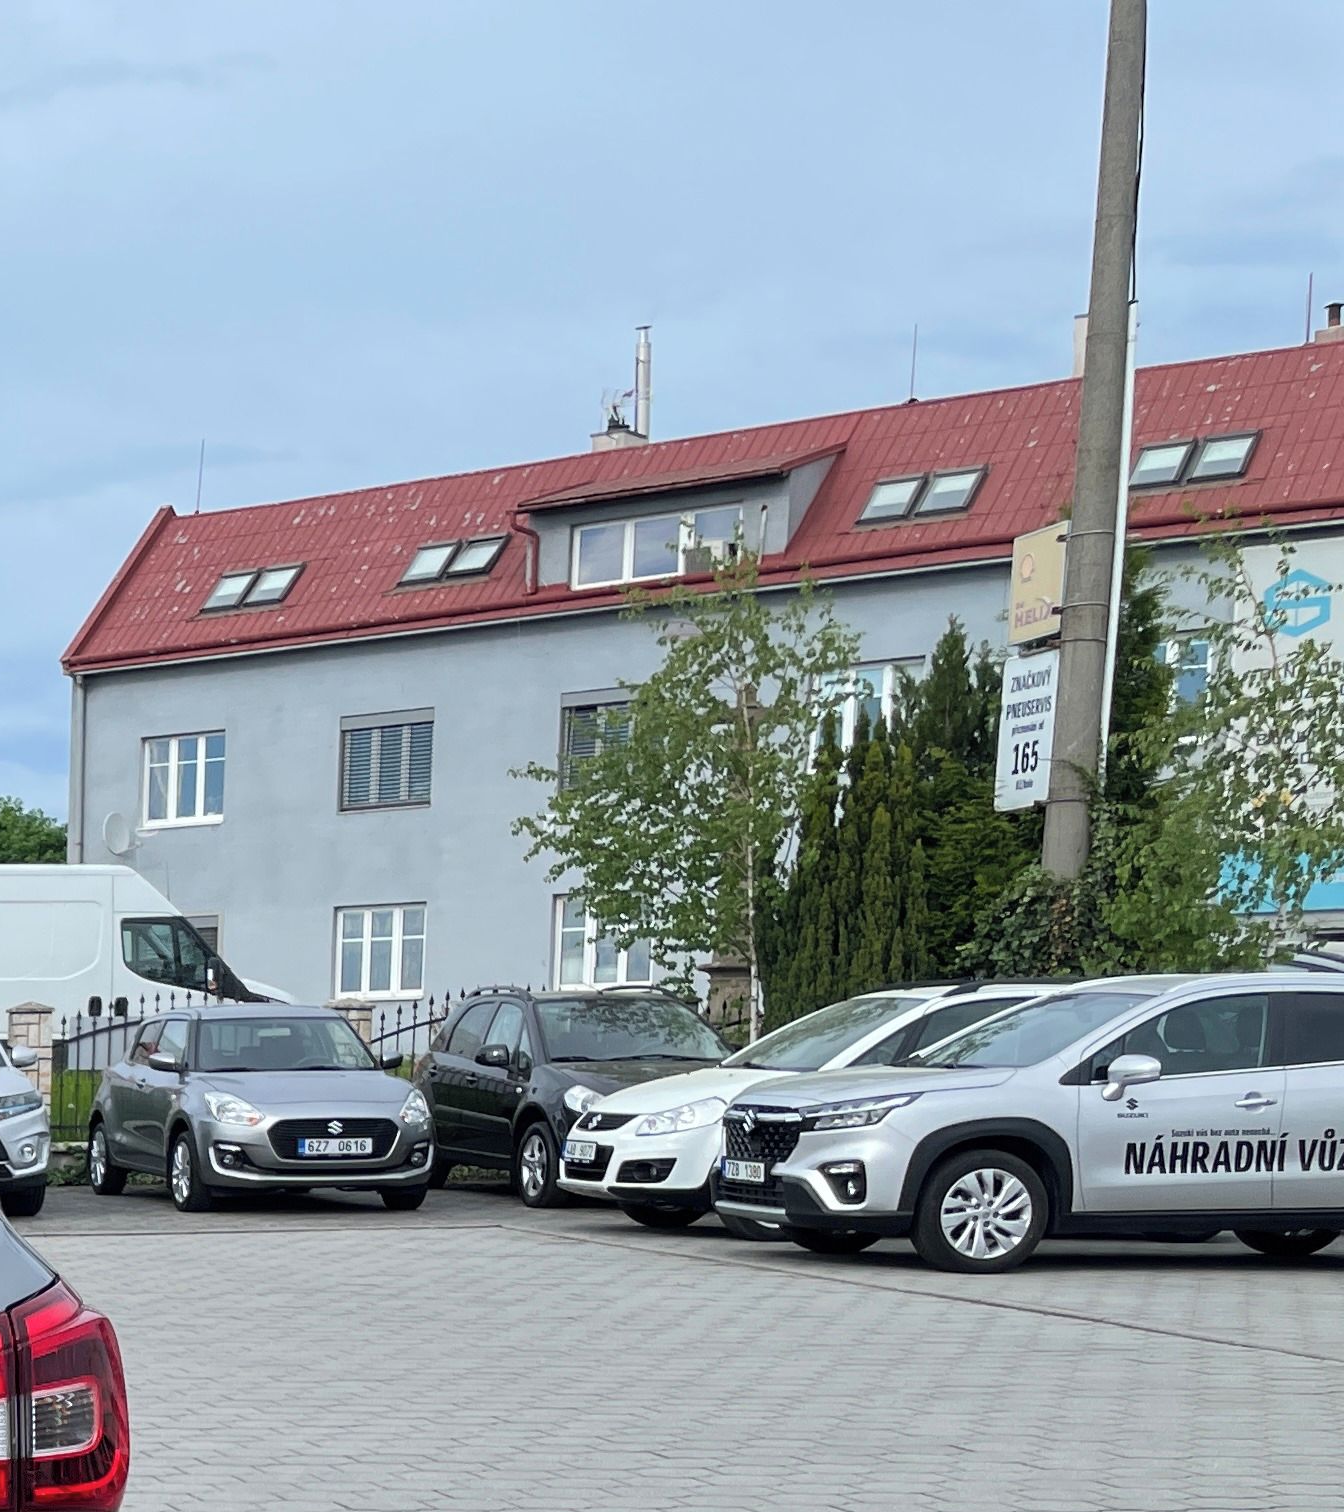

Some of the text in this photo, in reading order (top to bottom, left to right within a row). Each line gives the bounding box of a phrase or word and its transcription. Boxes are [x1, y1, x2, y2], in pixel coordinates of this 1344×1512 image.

[1010, 665, 1052, 694] ZNAČKOVÝ
[1006, 696, 1052, 720] PNEUSERVIS
[1011, 739, 1040, 775] 165
[307, 1139, 367, 1153] 6Z7 0616
[1124, 1132, 1290, 1175] NÁHRADNÍ
